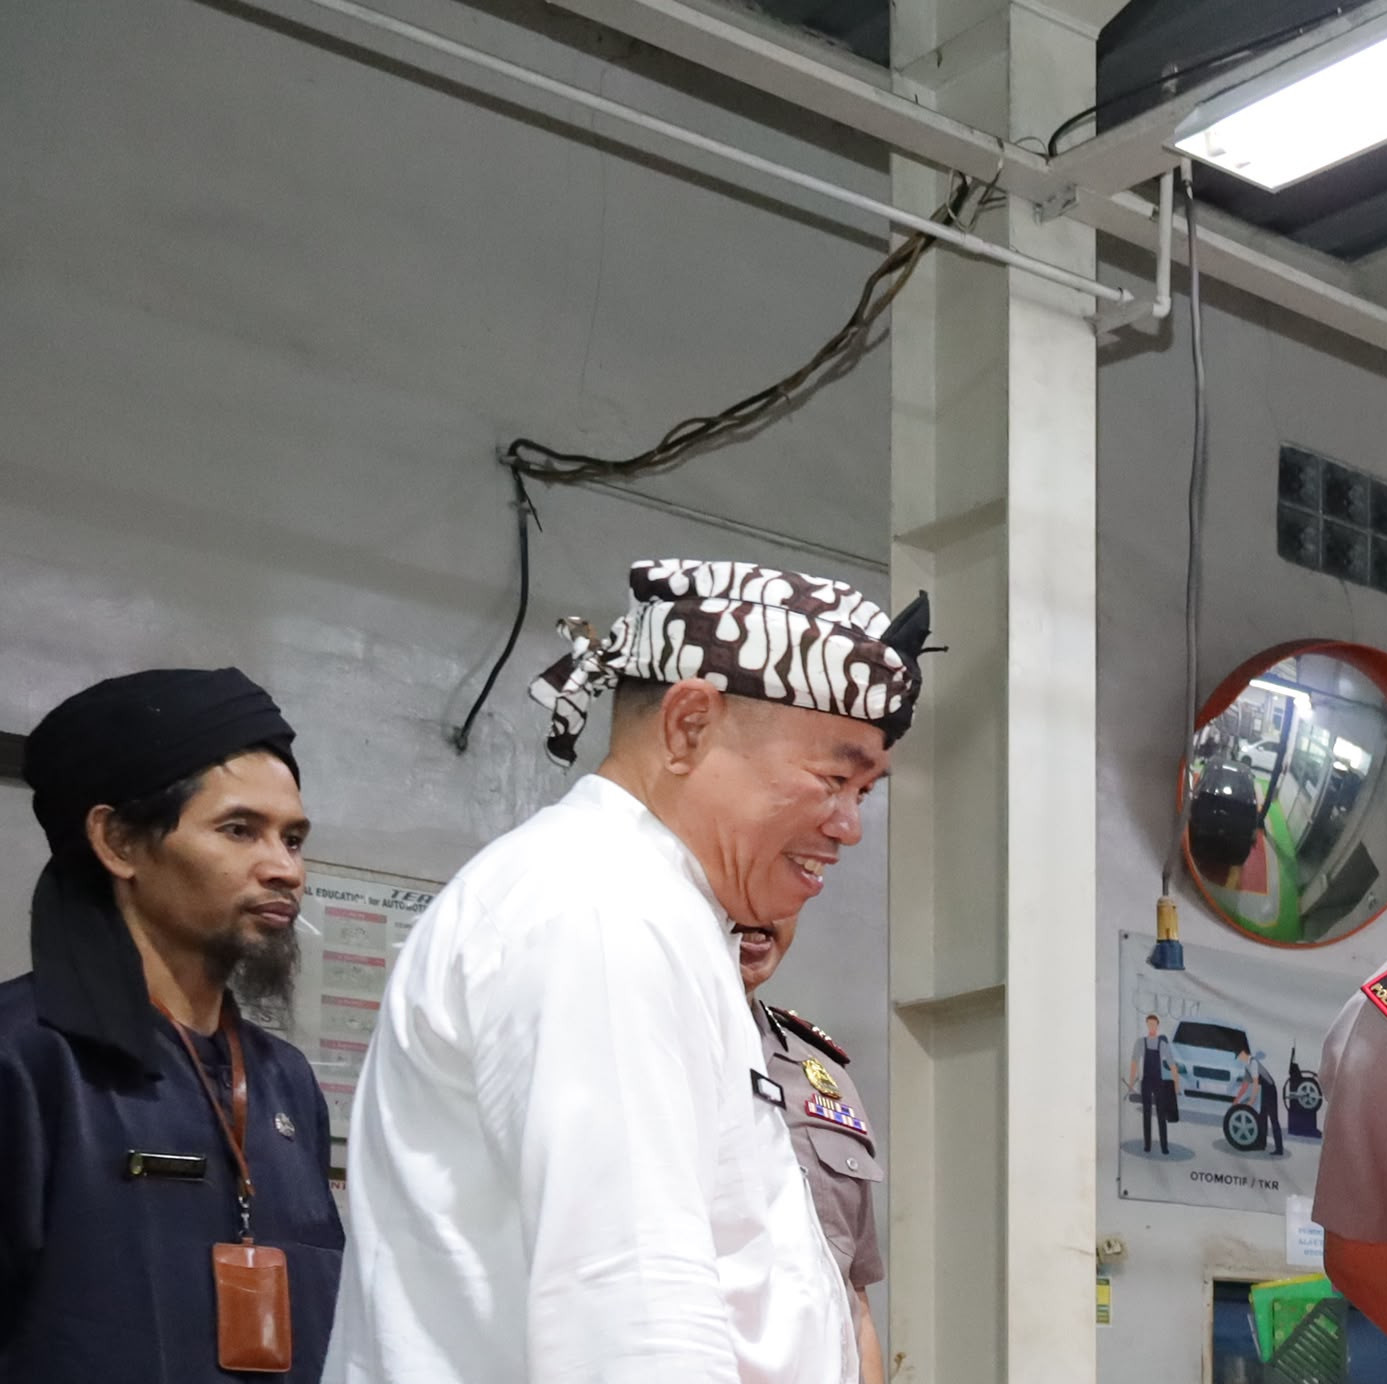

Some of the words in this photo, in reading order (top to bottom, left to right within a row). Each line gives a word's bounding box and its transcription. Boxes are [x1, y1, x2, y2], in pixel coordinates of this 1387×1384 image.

[316, 887, 366, 905] EDUCATI
[1190, 1171, 1248, 1186] OTOMOTIF
[1259, 1180, 1279, 1191] TKR
